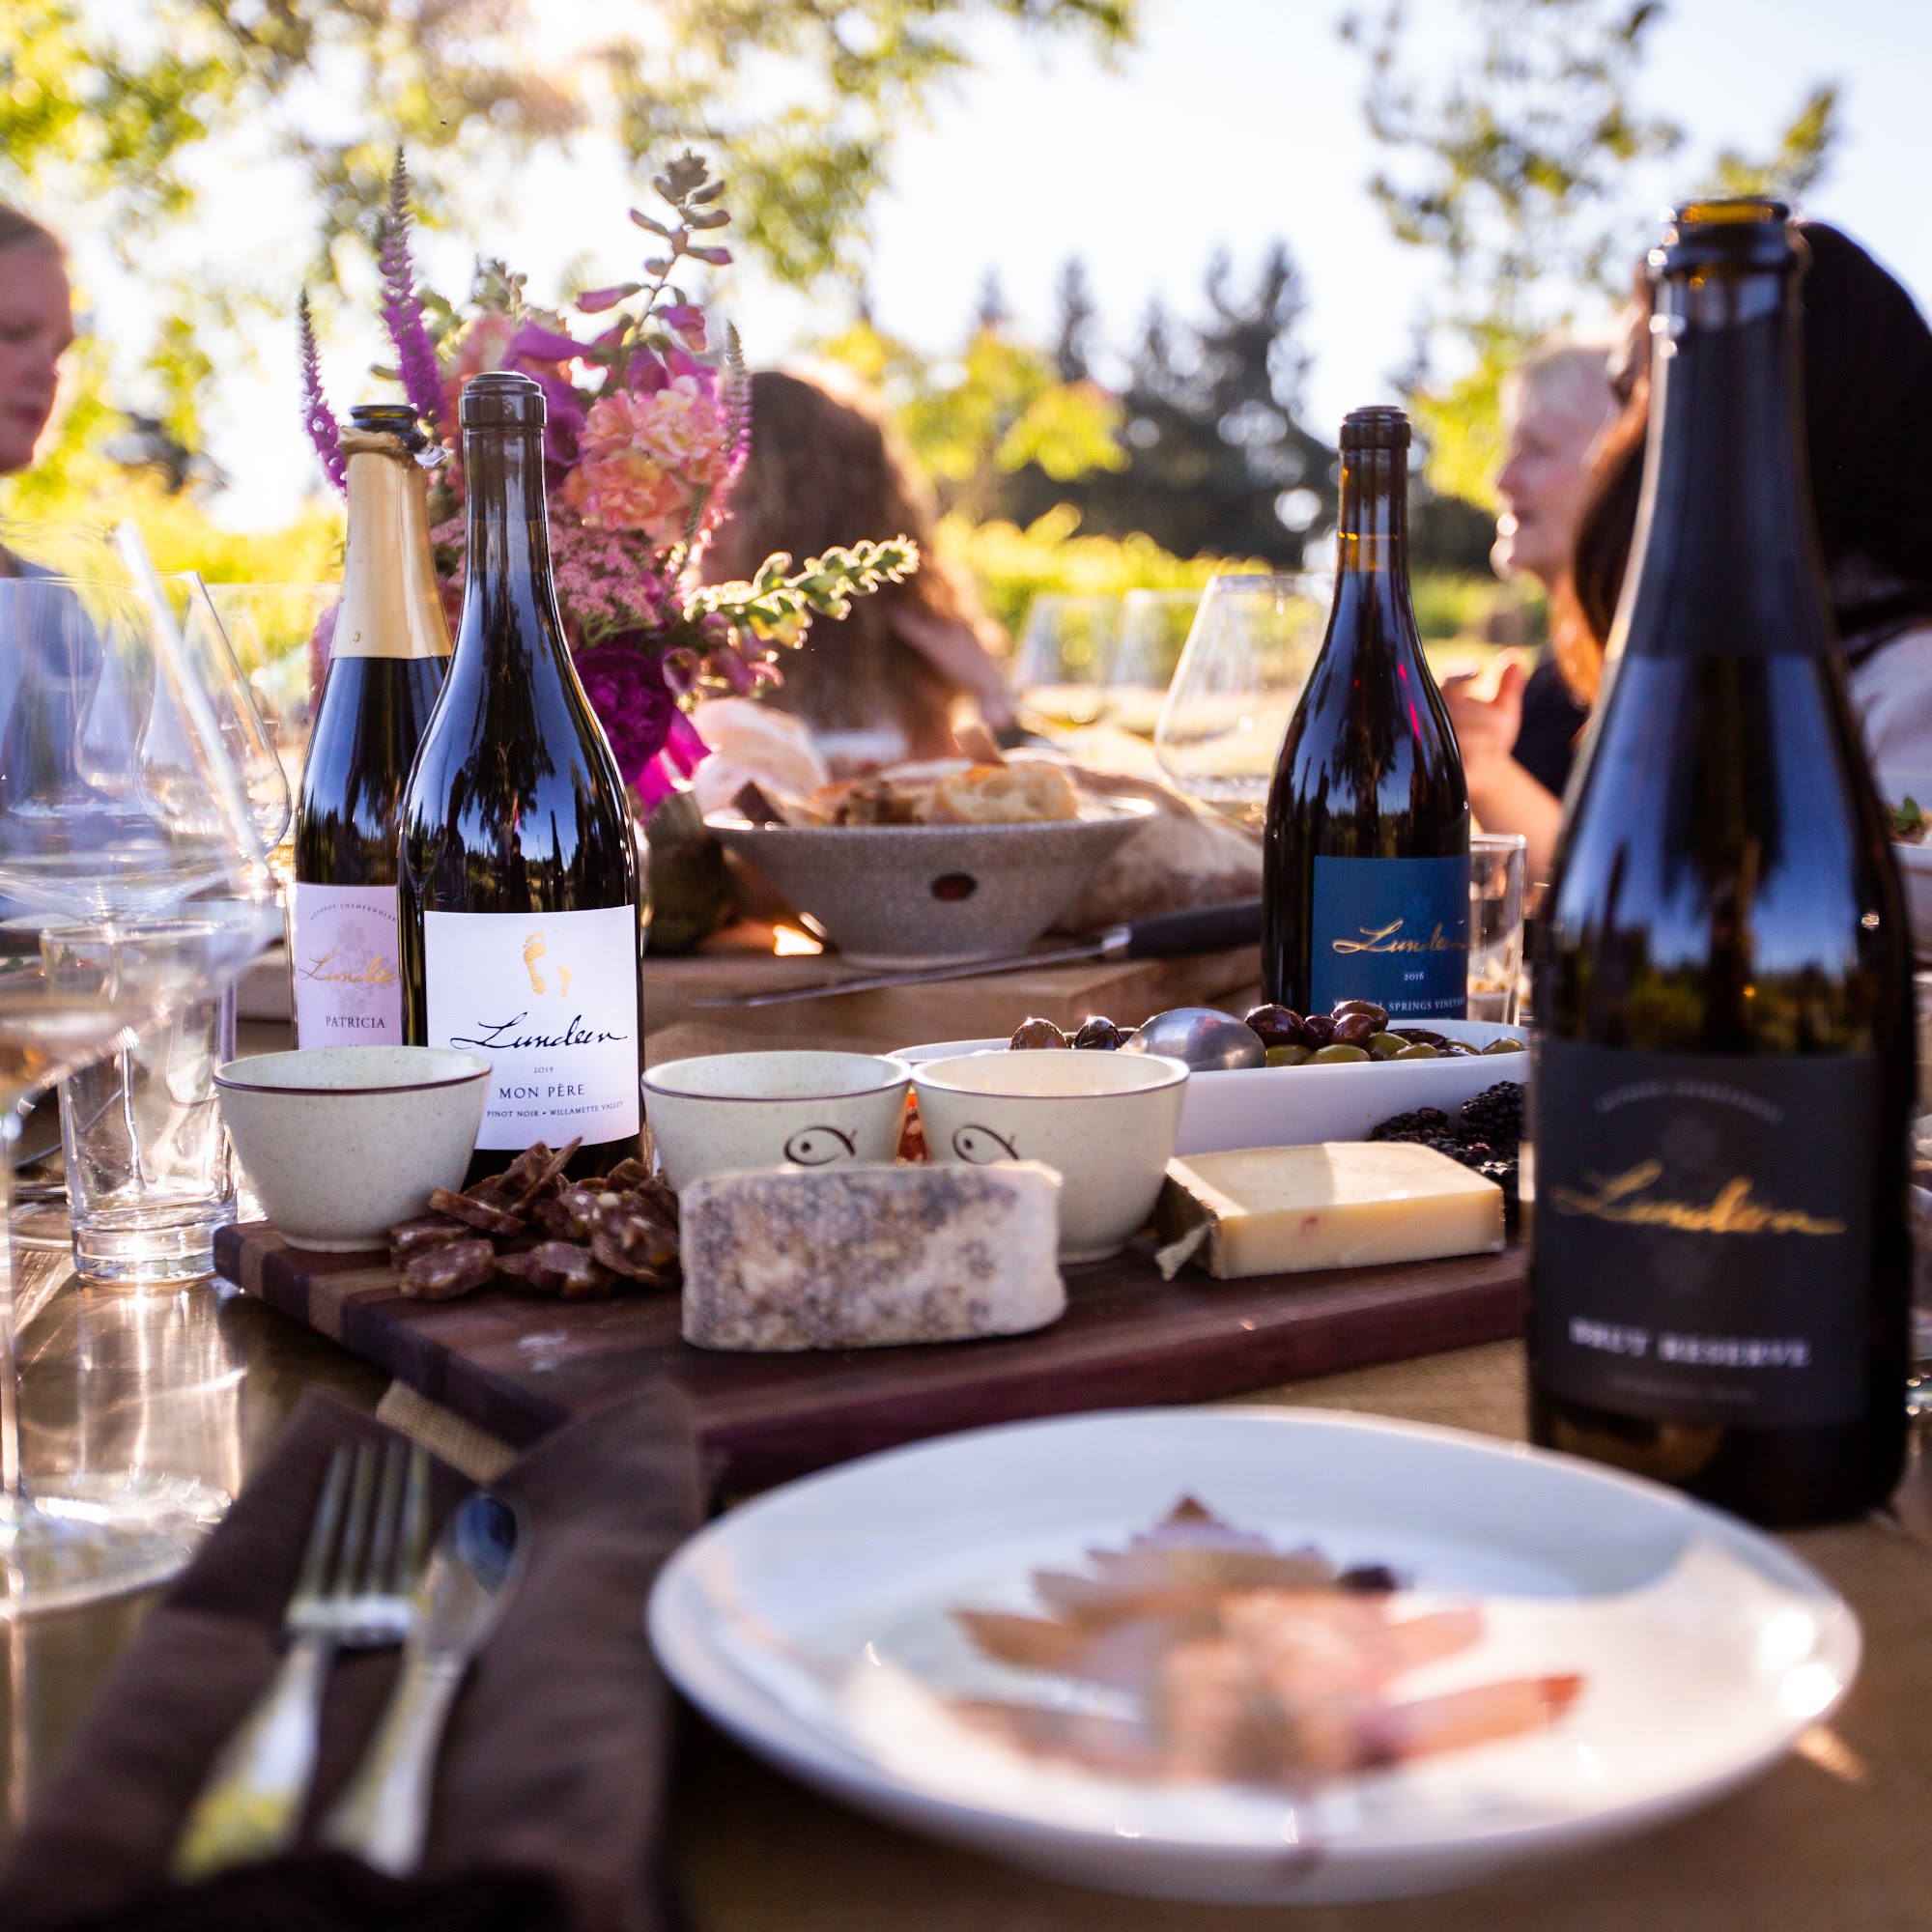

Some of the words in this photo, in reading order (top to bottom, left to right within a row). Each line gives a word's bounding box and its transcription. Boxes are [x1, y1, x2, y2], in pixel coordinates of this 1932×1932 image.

[1404, 972, 1425, 981] 2016
[1388, 1001, 1433, 1011] SPRINGS
[325, 1015, 386, 1029] PATRICIA
[449, 1011, 628, 1050] Lundeen
[533, 1065, 554, 1074] 2019
[498, 1087, 539, 1099] MON
[547, 1083, 585, 1098] PÈRE
[549, 1104, 599, 1117] WILLAMETTE
[601, 1100, 624, 1111] VALLEY
